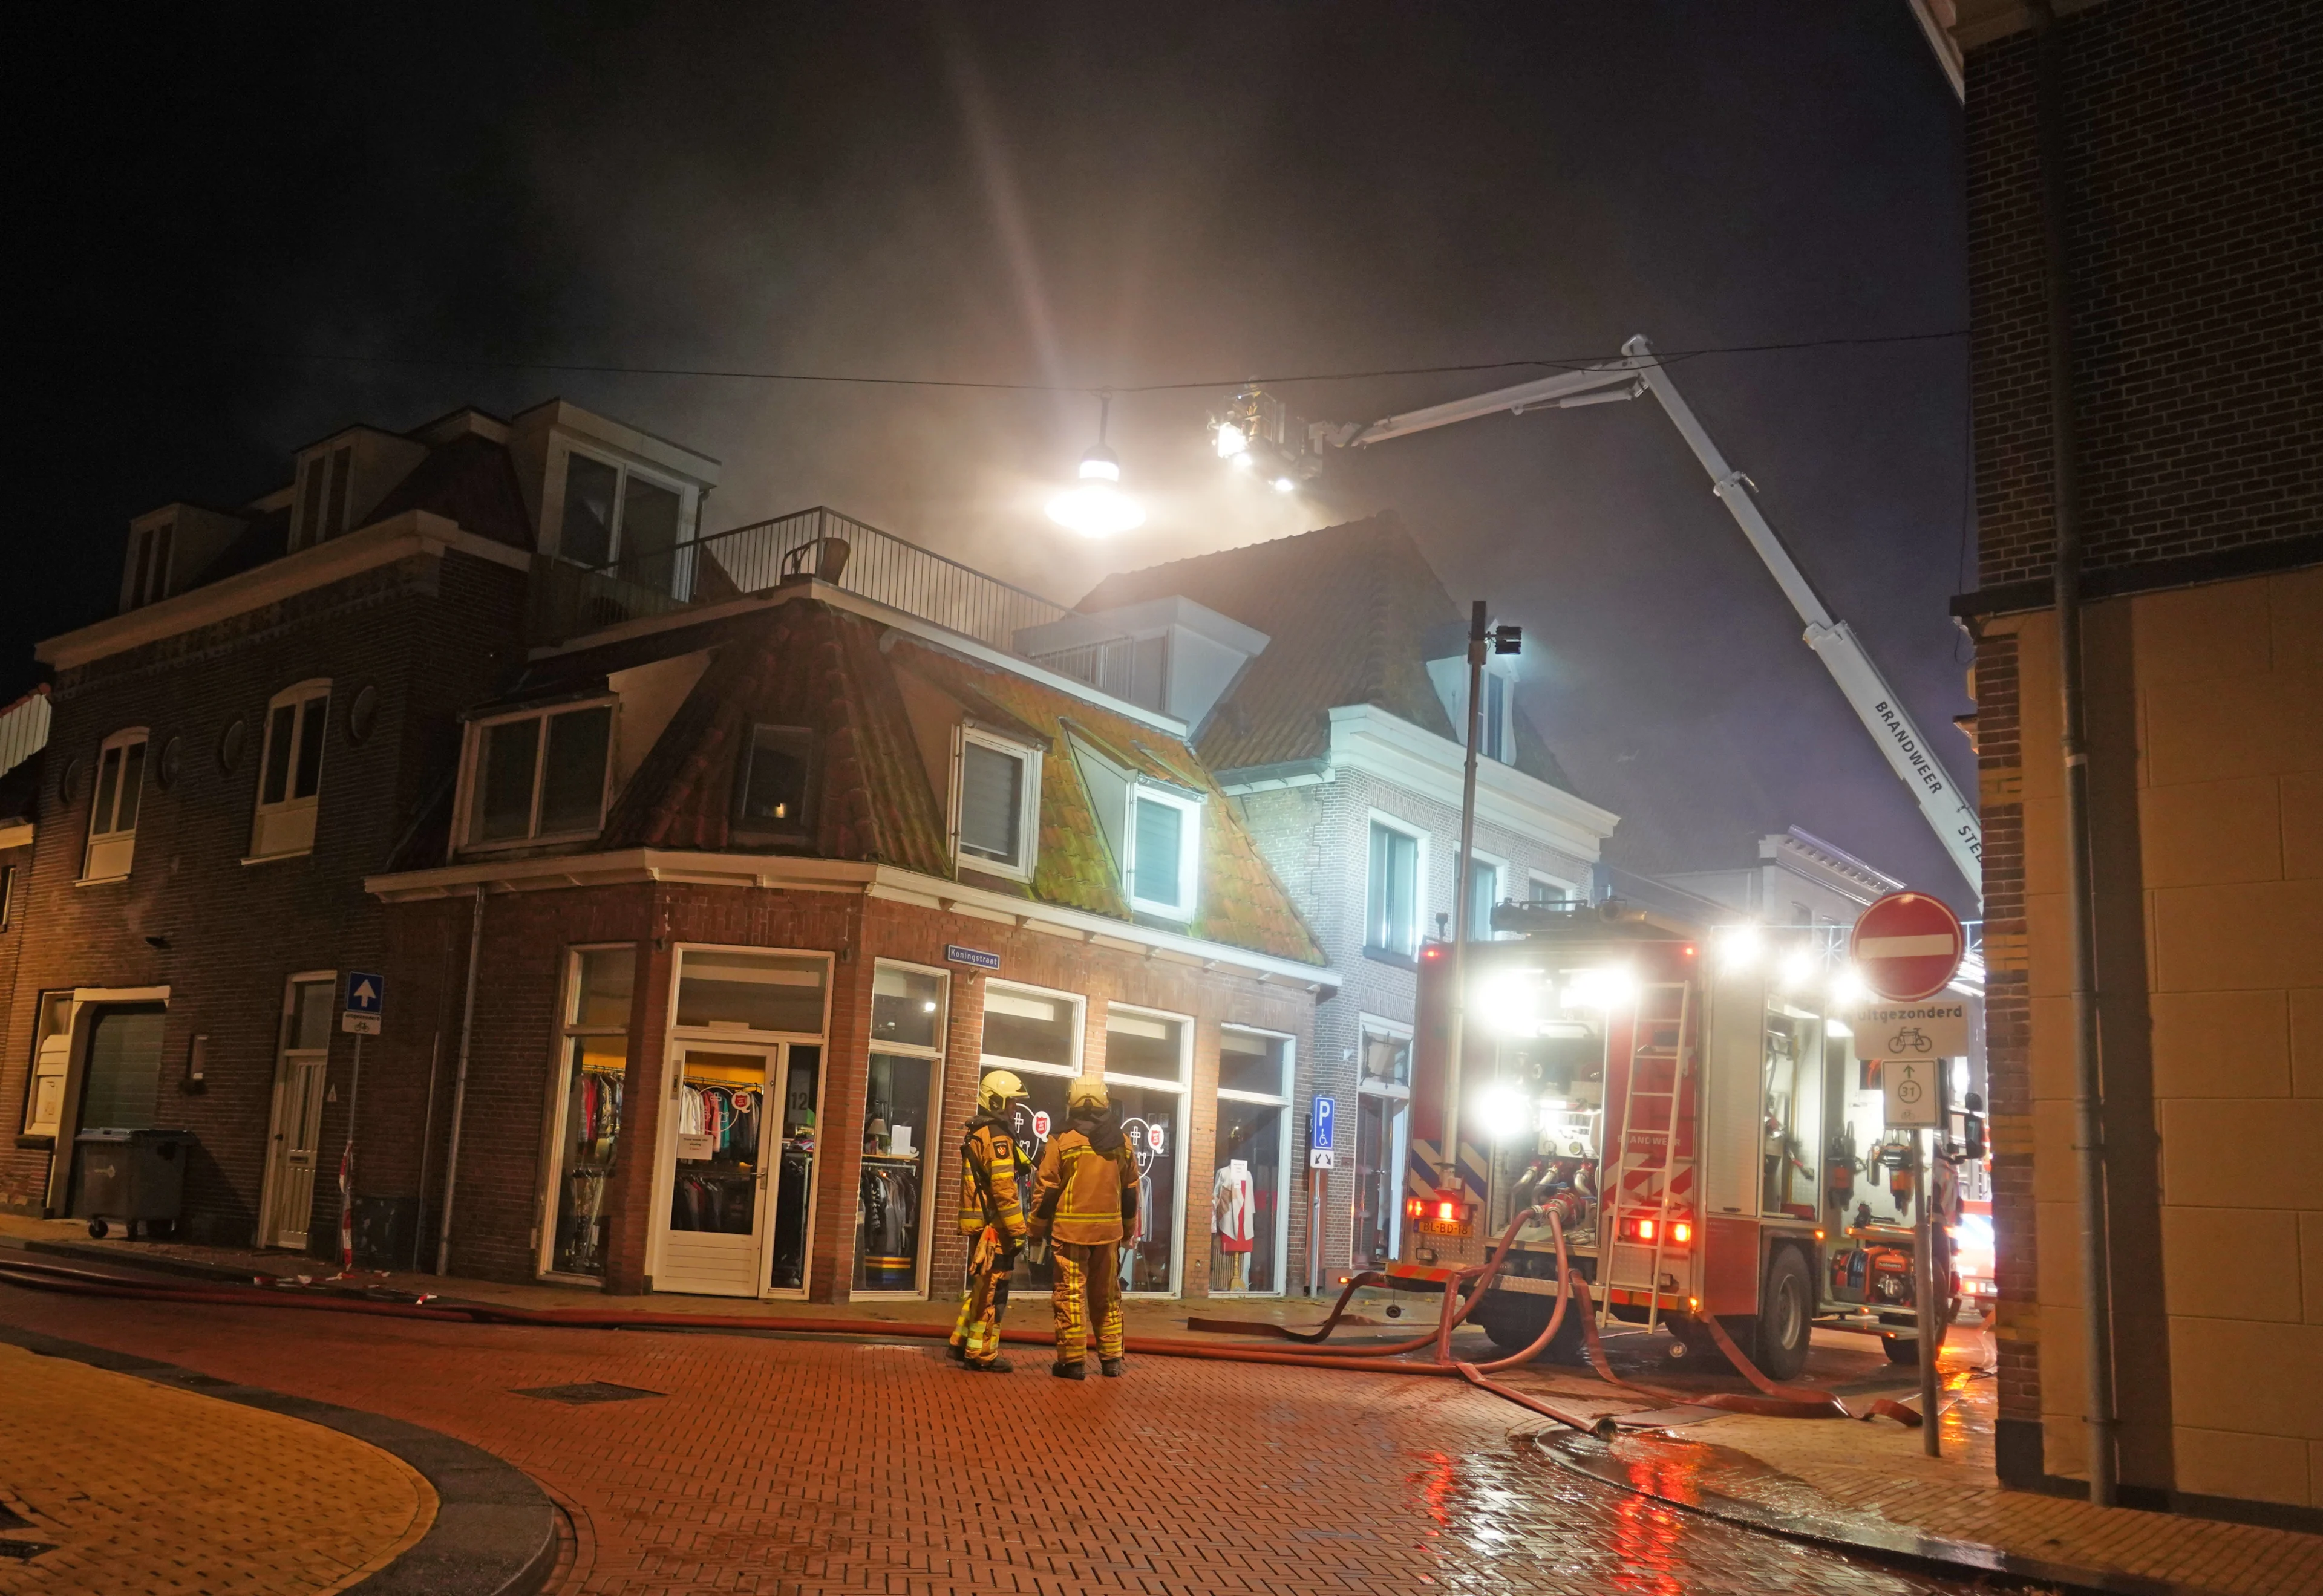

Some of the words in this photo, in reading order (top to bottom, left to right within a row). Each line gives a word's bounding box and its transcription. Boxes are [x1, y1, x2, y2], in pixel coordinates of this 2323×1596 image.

[1875, 701, 1942, 795] BRANDWEER
[950, 948, 998, 965] Koningstraat
[1858, 1005, 1962, 1023] uitgezonderd
[1901, 1086, 1915, 1097] 31
[792, 1092, 808, 1110] 12
[1319, 1101, 1330, 1127] P
[1618, 1135, 1681, 1147] BANDWER
[1423, 1221, 1468, 1235] BL-BD-18
